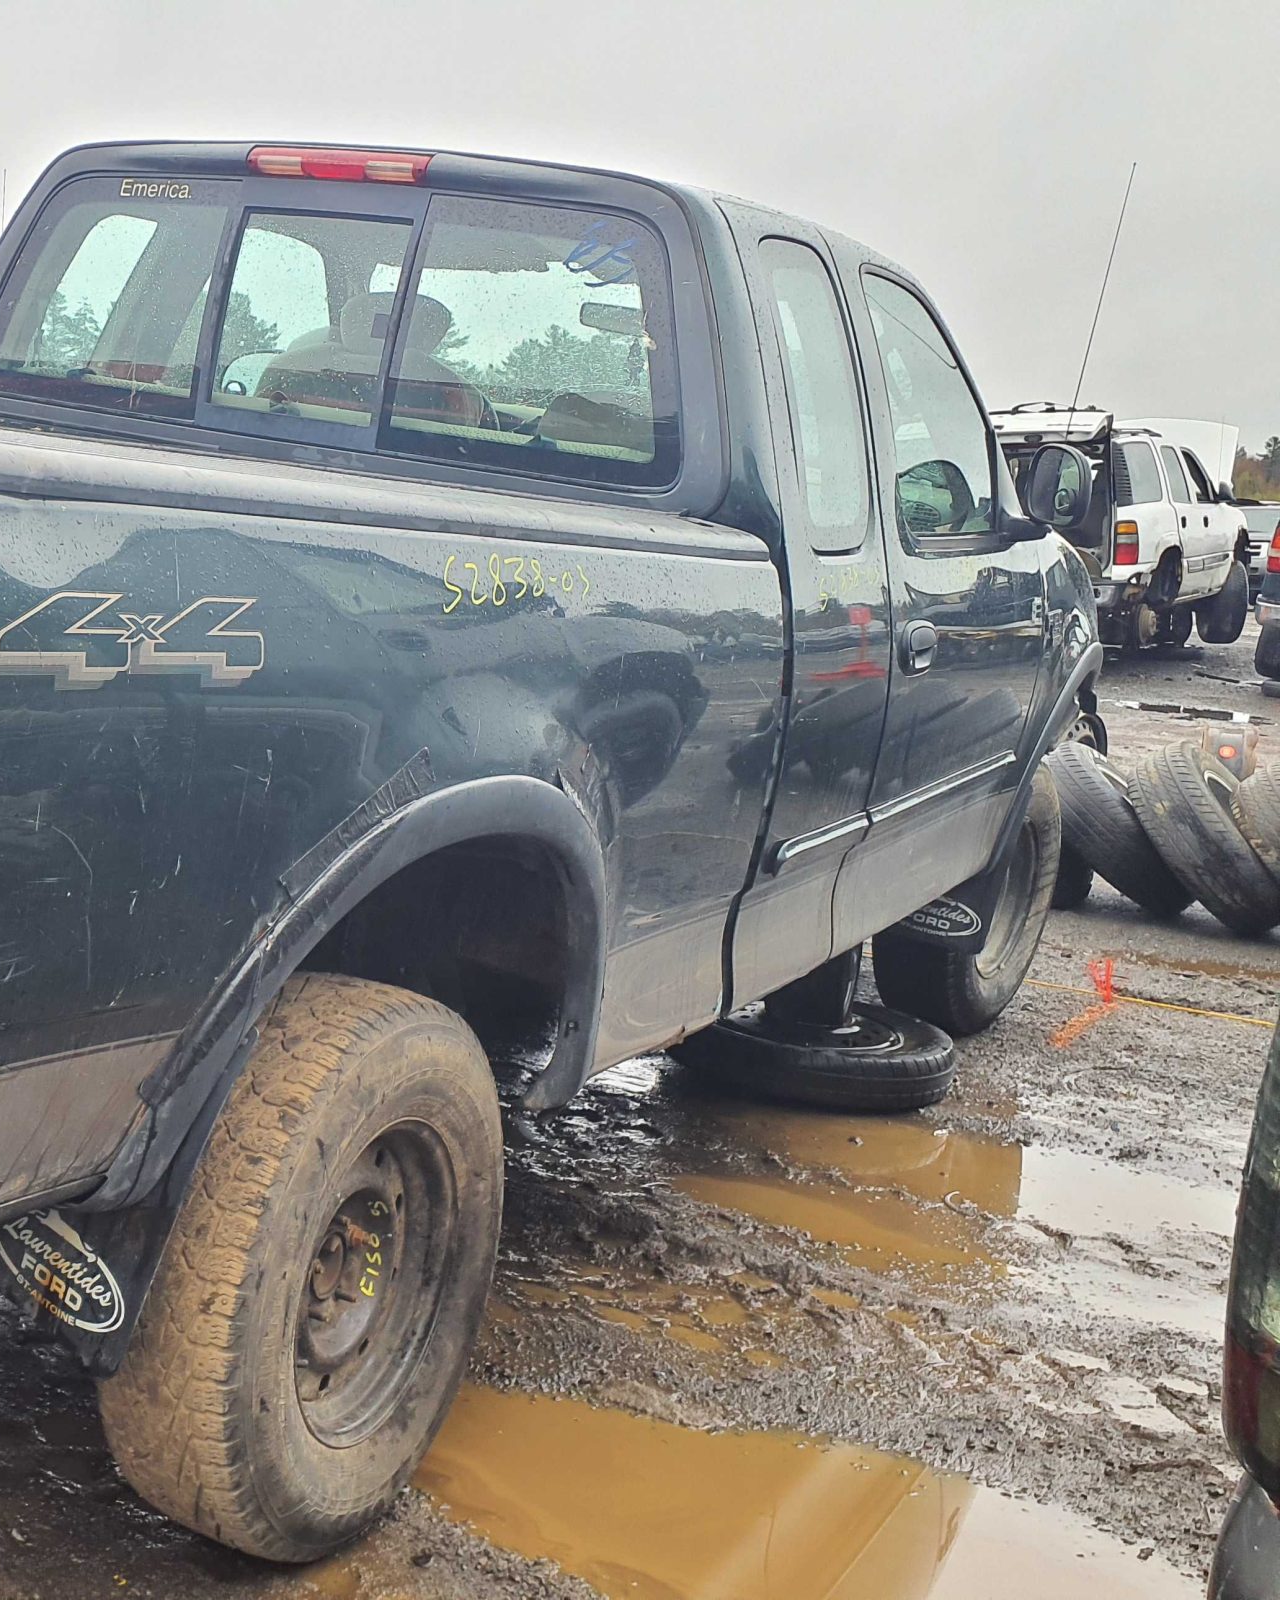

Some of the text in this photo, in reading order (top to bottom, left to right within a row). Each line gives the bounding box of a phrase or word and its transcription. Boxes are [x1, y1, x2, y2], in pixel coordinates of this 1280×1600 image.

[3, 1216, 112, 1308] Laurentides
[21, 1252, 83, 1312] FORD
[16, 1273, 76, 1327] ST-ANTOINE
